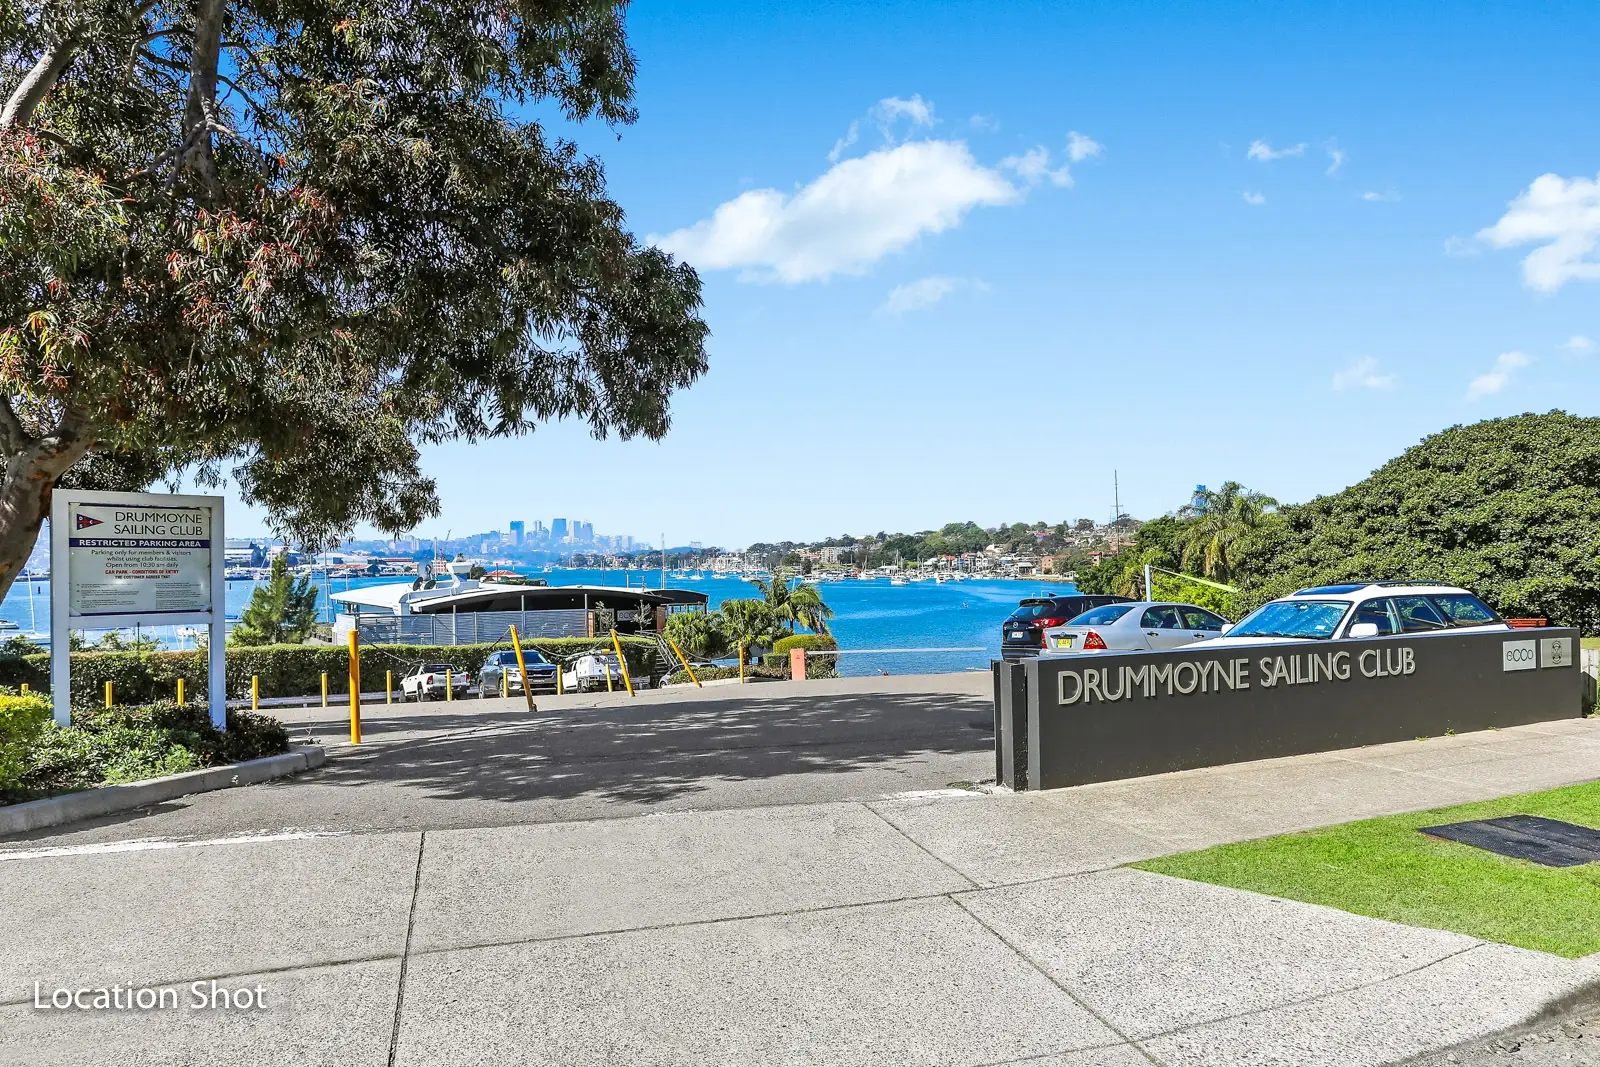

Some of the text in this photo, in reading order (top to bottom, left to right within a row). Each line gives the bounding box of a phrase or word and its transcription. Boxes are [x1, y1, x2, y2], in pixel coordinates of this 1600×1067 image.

[115, 511, 202, 524] DRUMMOYNE
[114, 524, 203, 536] SAILING CLUB
[79, 539, 137, 547] RESTRICTED
[1057, 647, 1417, 706] DRUMMOYNE SAILING CLUB
